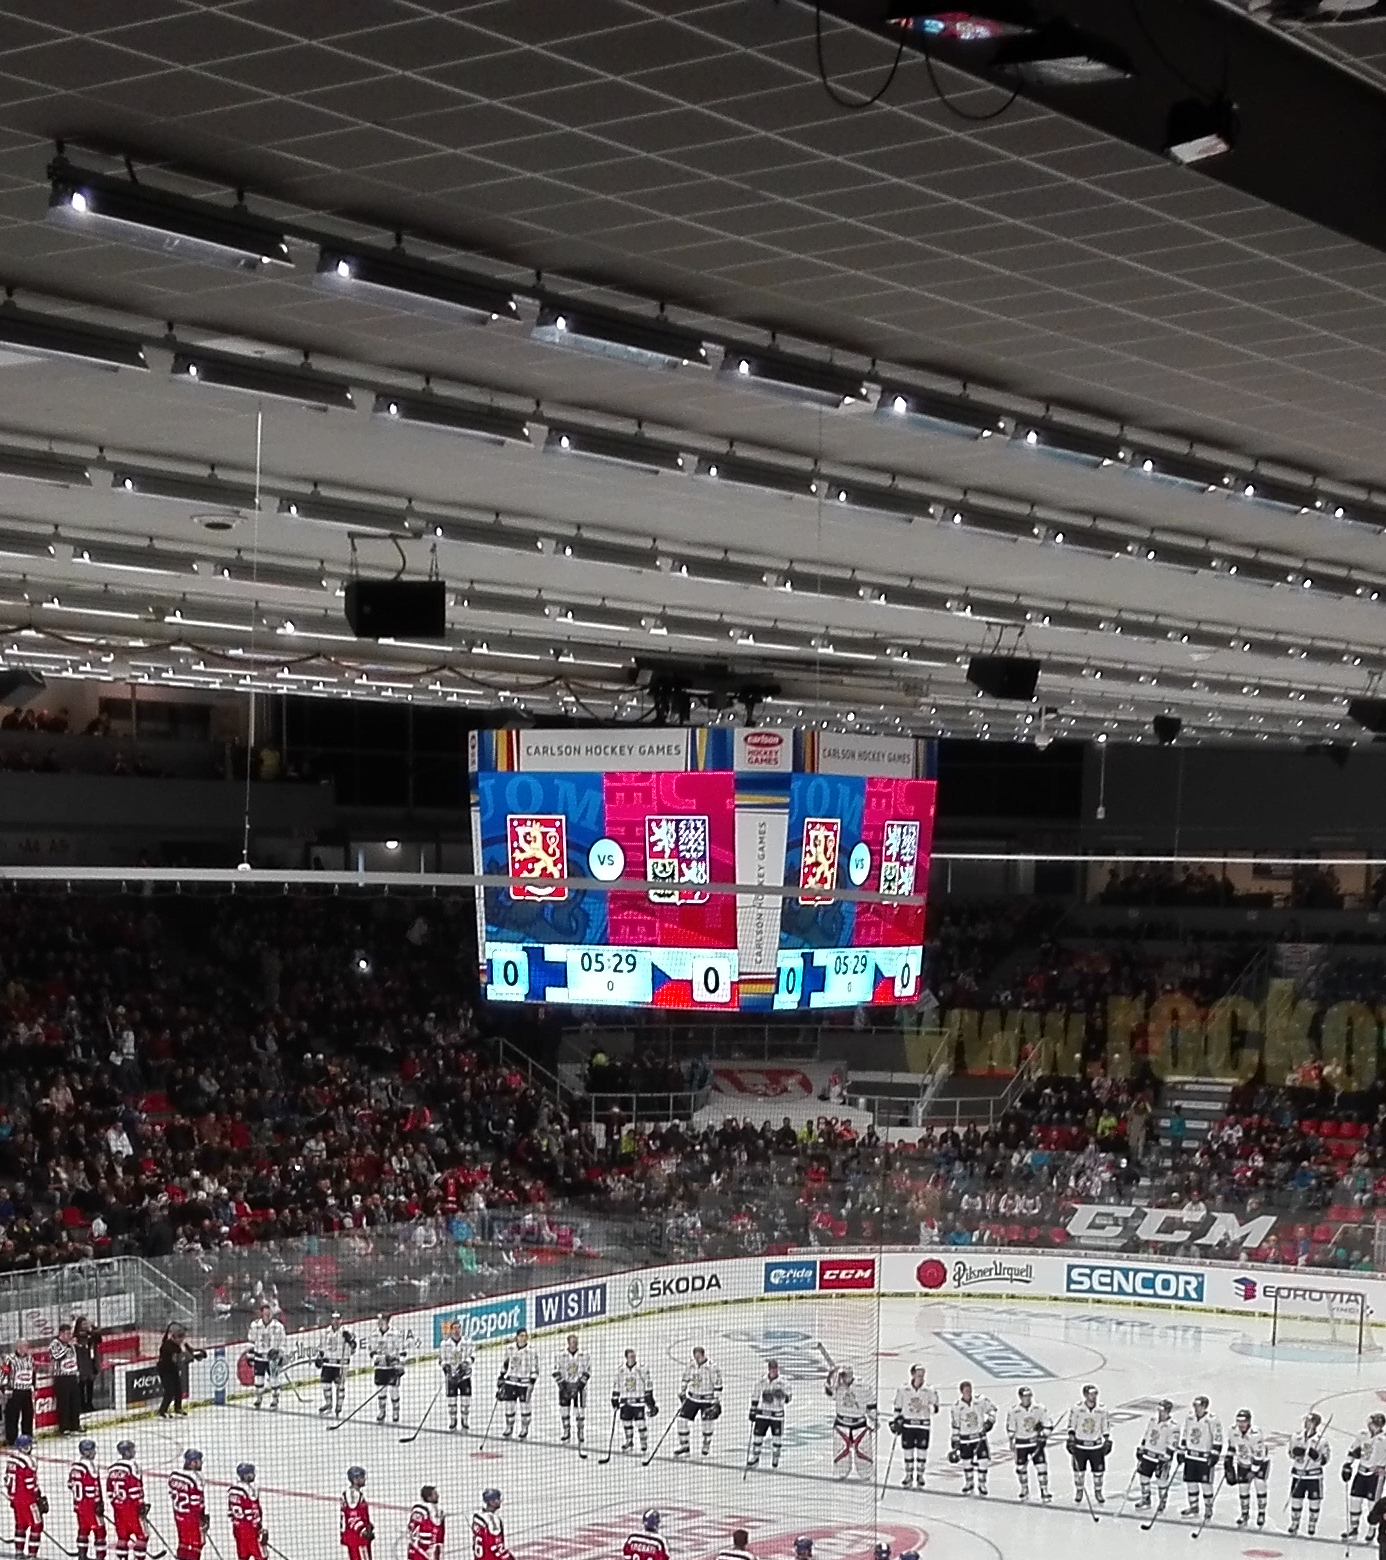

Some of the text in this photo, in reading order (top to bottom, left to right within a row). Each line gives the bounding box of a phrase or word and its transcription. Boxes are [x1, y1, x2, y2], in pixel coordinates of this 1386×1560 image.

[525, 743, 682, 757] CARLSON HOCKEY GAMES
[747, 749, 779, 758] HOCKEY
[747, 757, 779, 766] GAMES
[821, 748, 912, 766] CARLSON HOCKEY GAMES
[757, 820, 767, 861] GAMES
[597, 854, 615, 866] VS
[755, 865, 766, 911] HOKEY
[504, 961, 519, 986] 0
[580, 952, 637, 974] 05:29
[833, 955, 868, 976] 05:29
[606, 980, 615, 992] 0
[704, 966, 720, 995] 0
[786, 966, 797, 995] 0
[900, 963, 911, 989] 0
[1065, 1202, 1279, 1249] CCM
[823, 1269, 872, 1280] CCM
[953, 1259, 1034, 1289] Pilsner Urquell
[1069, 1268, 1199, 1299] SENCOR
[648, 1273, 722, 1299] ŠKODA
[1262, 1284, 1366, 1305] EUROVIA
